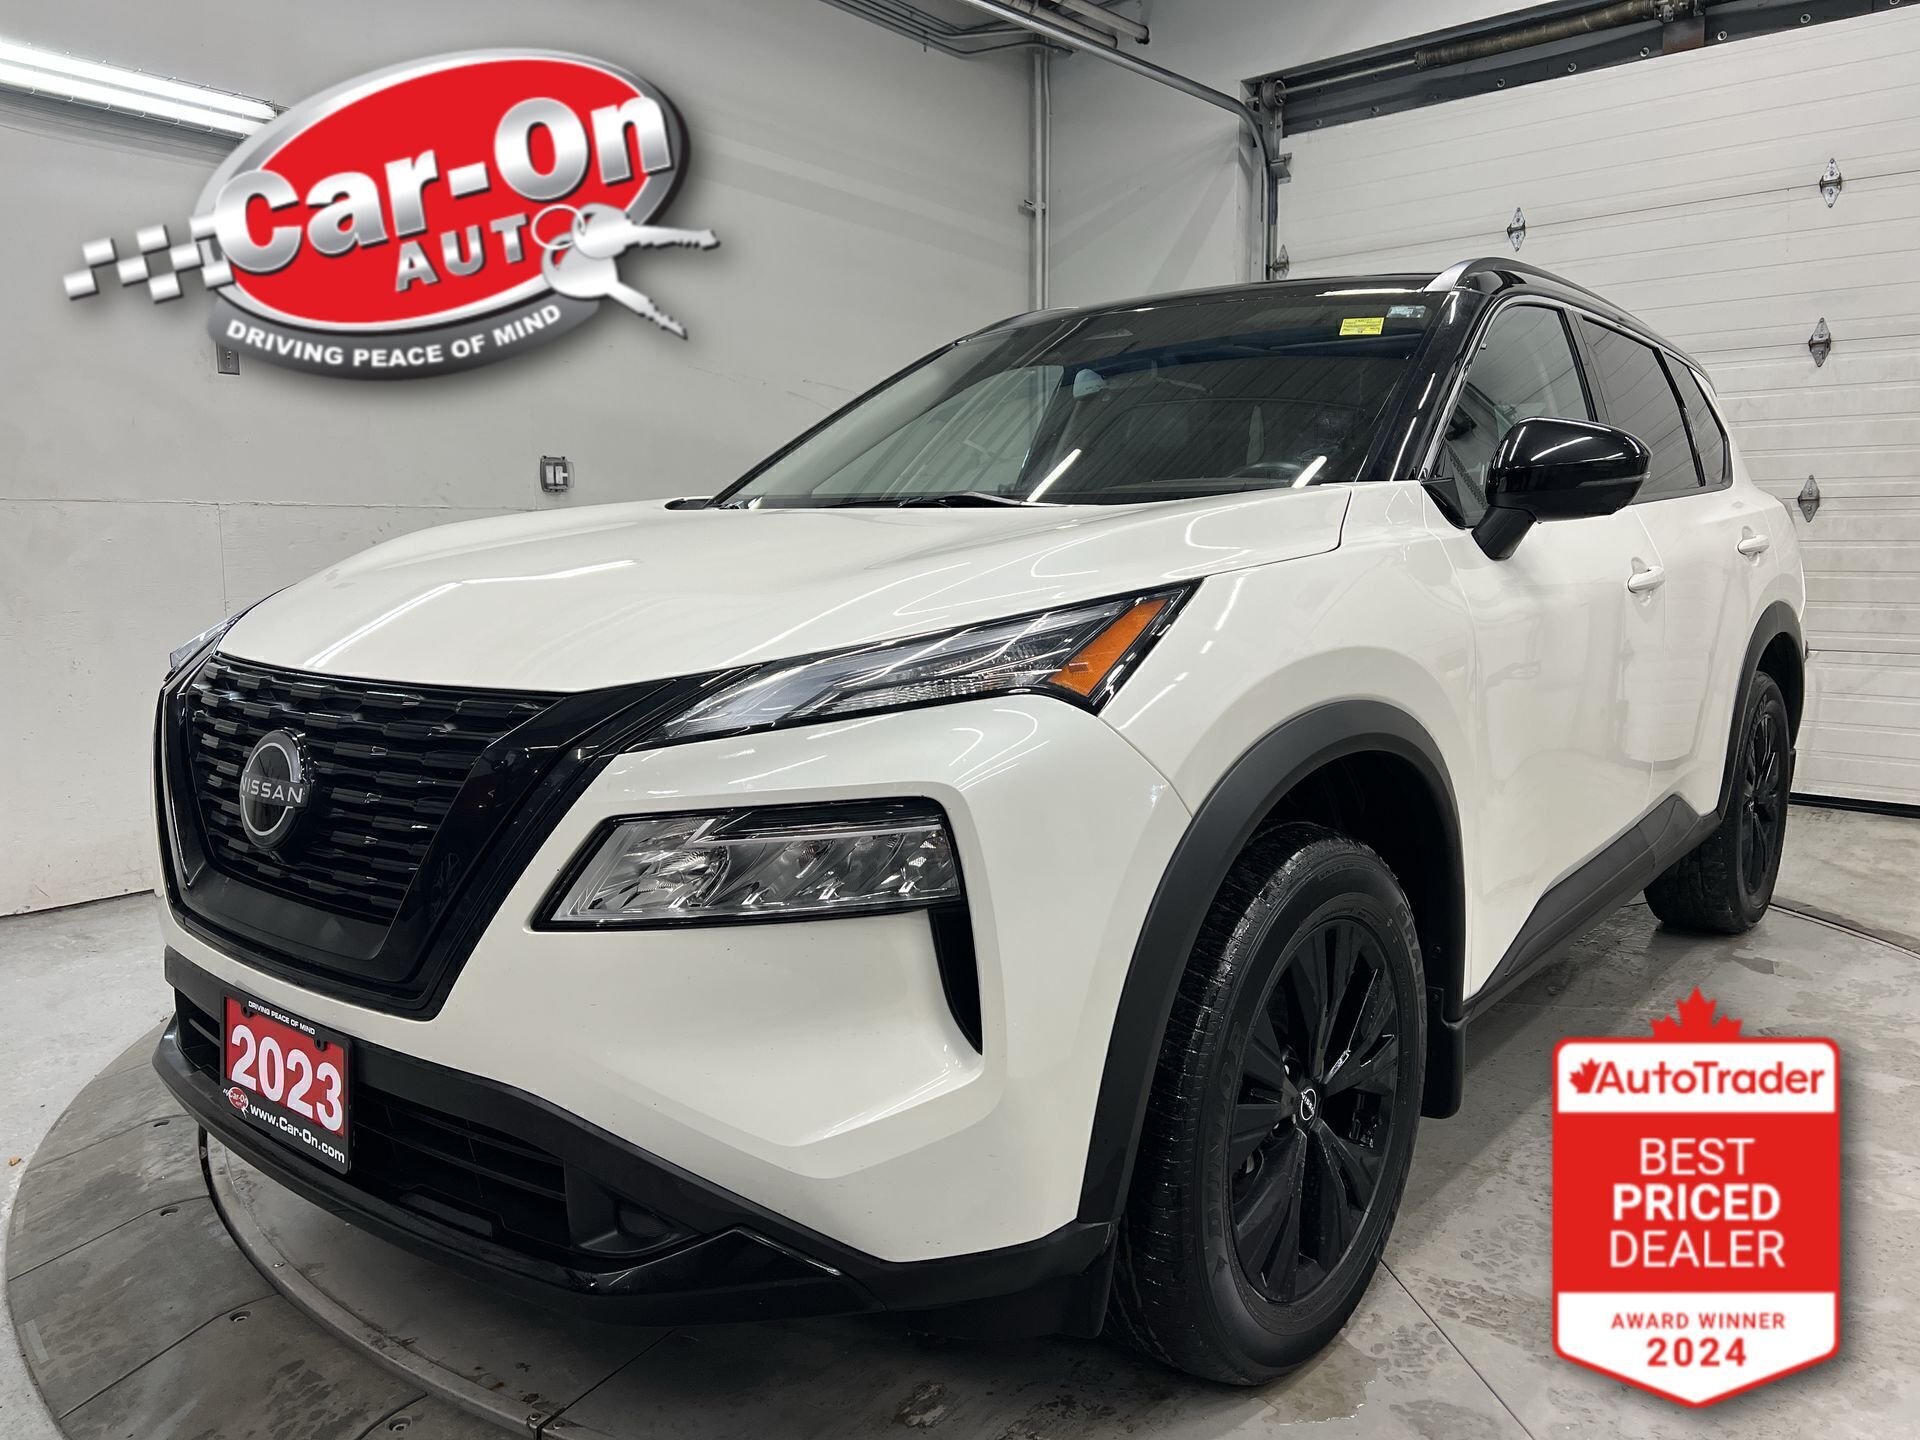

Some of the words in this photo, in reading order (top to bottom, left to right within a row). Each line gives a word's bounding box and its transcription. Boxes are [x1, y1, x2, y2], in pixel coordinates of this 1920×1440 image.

[241, 775, 303, 803] NISSAN
[248, 1000, 271, 1016] DRIVING
[270, 1010, 290, 1025] PEACE
[290, 1018, 300, 1028] OF
[299, 1022, 316, 1036] MIND
[231, 1024, 343, 1132] 2023
[249, 1104, 345, 1164] www.Car-On.com
